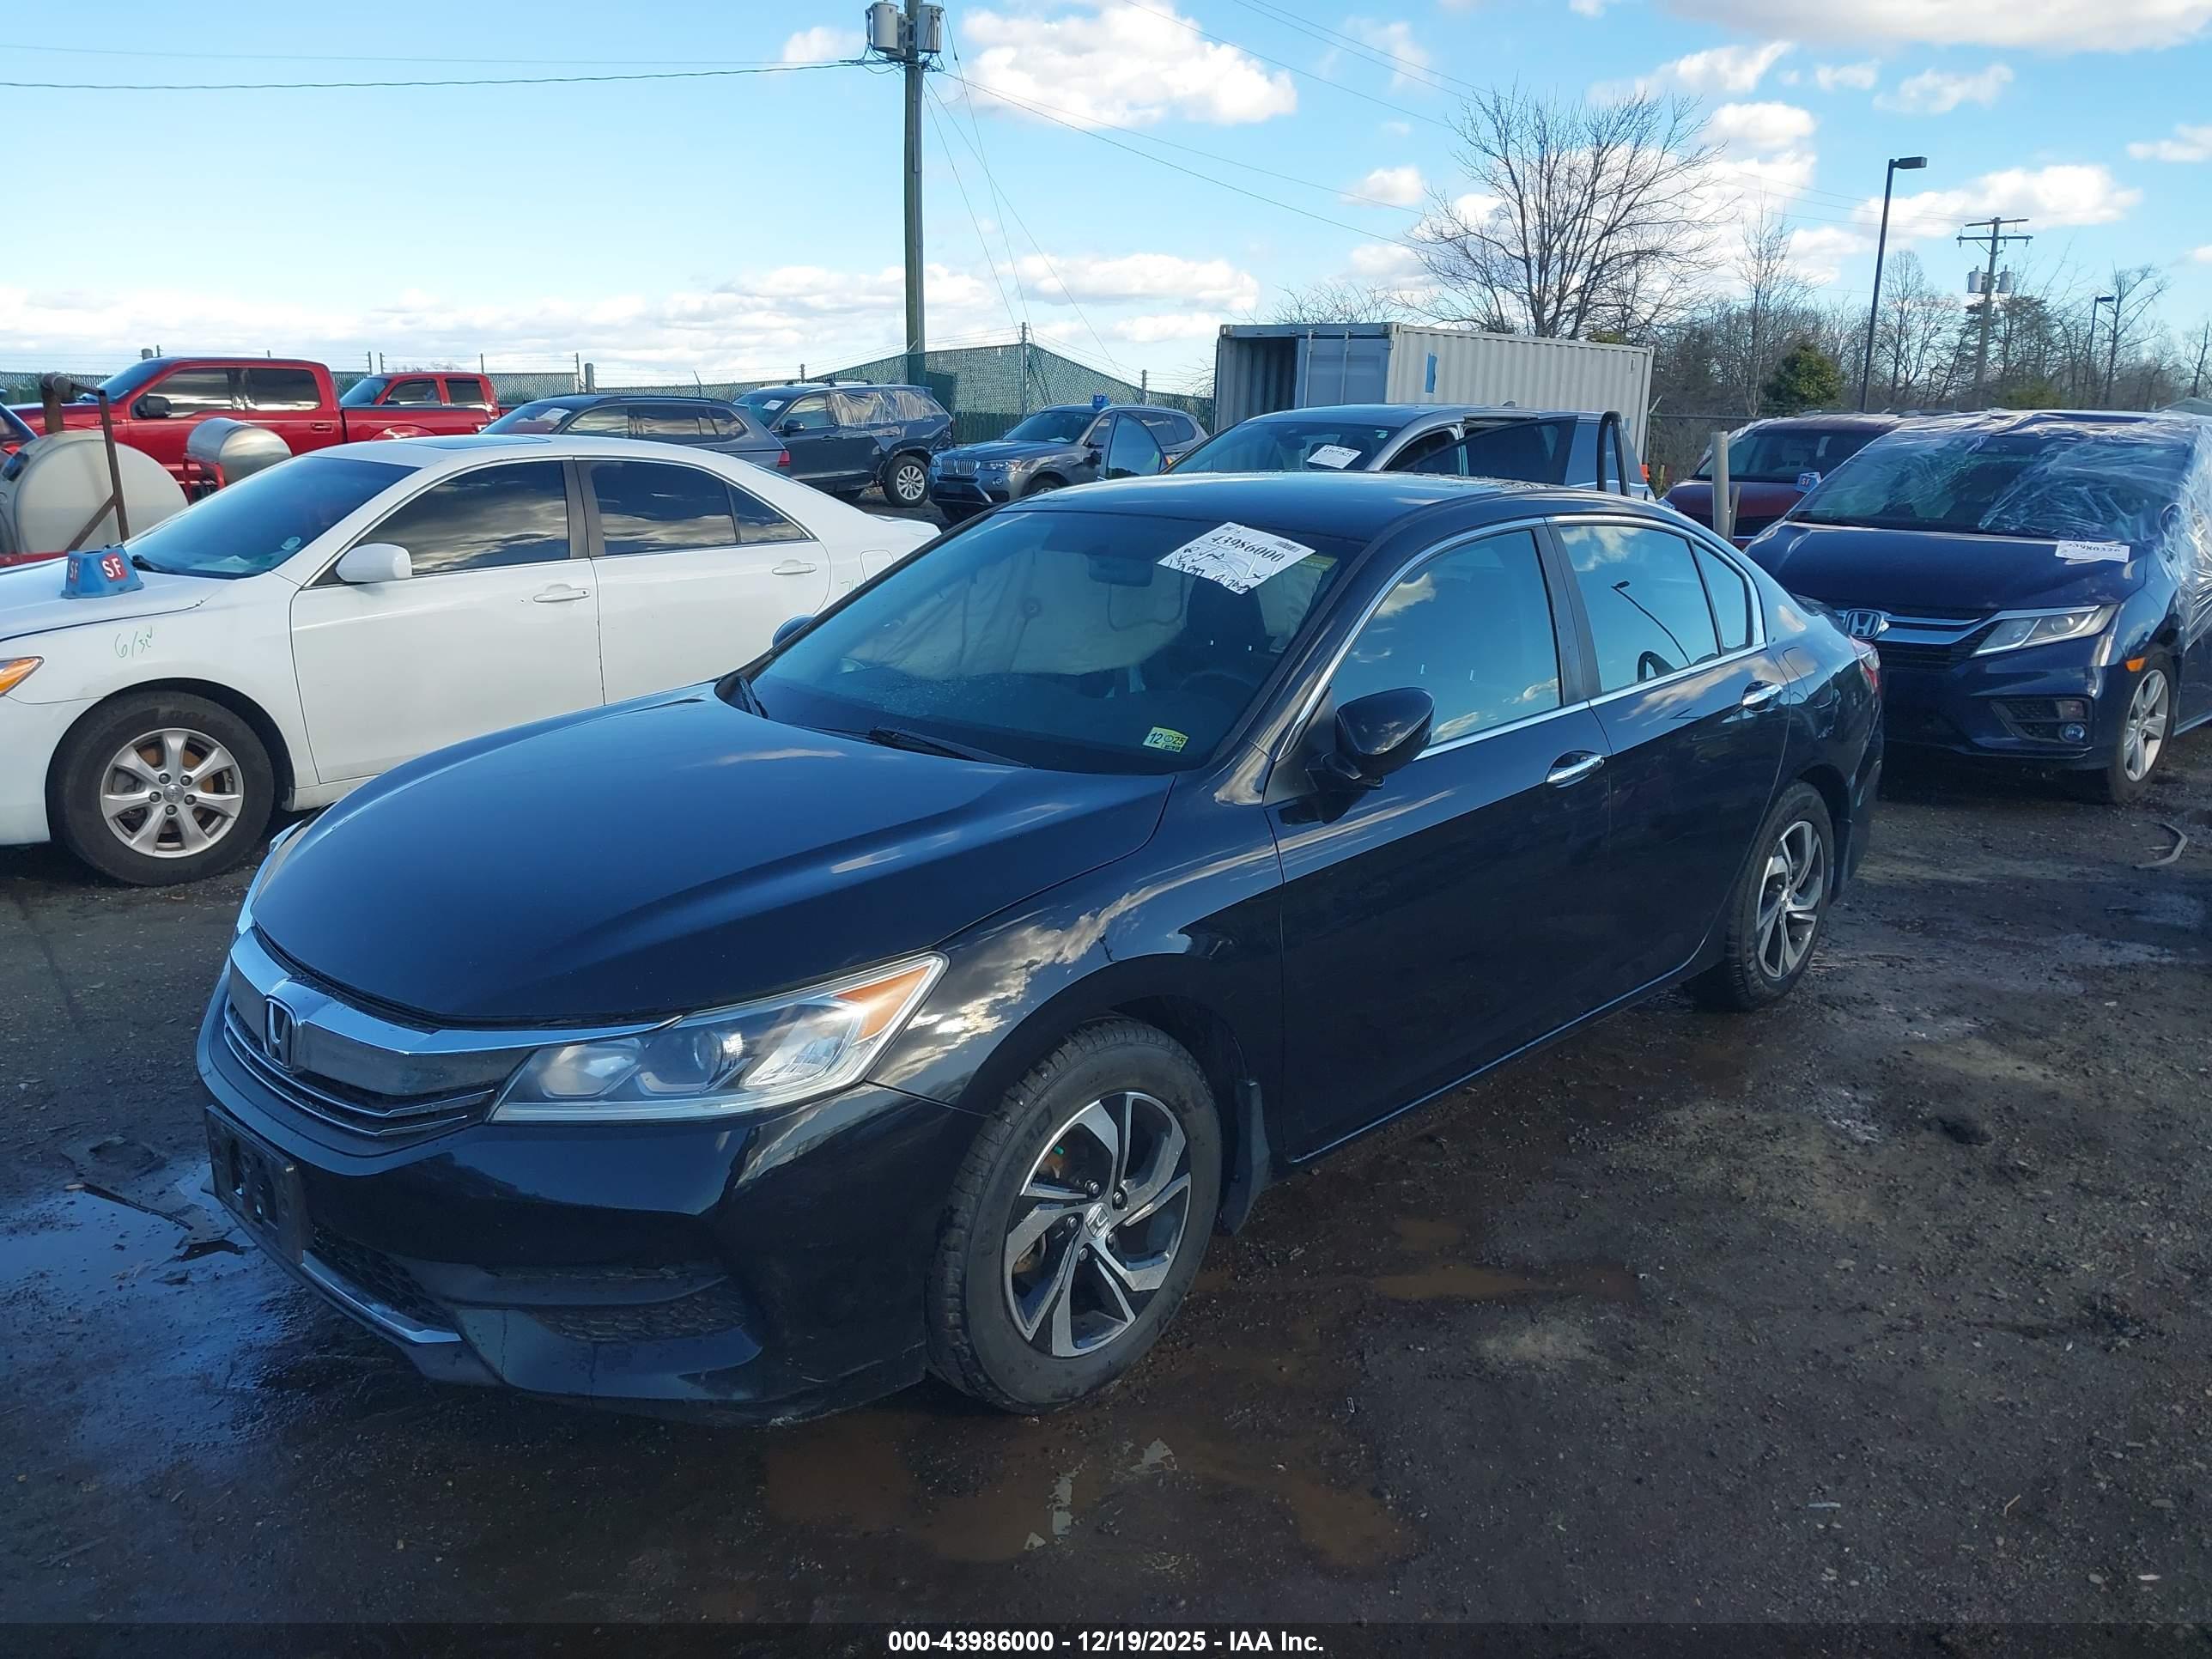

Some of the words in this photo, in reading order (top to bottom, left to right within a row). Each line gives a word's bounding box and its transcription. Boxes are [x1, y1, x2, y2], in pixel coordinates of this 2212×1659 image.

[1211, 535, 1286, 563] 43986000
[70, 561, 79, 580] SF
[101, 557, 122, 578] SF
[1149, 732, 1164, 744] 12
[1172, 736, 1186, 745] 25
